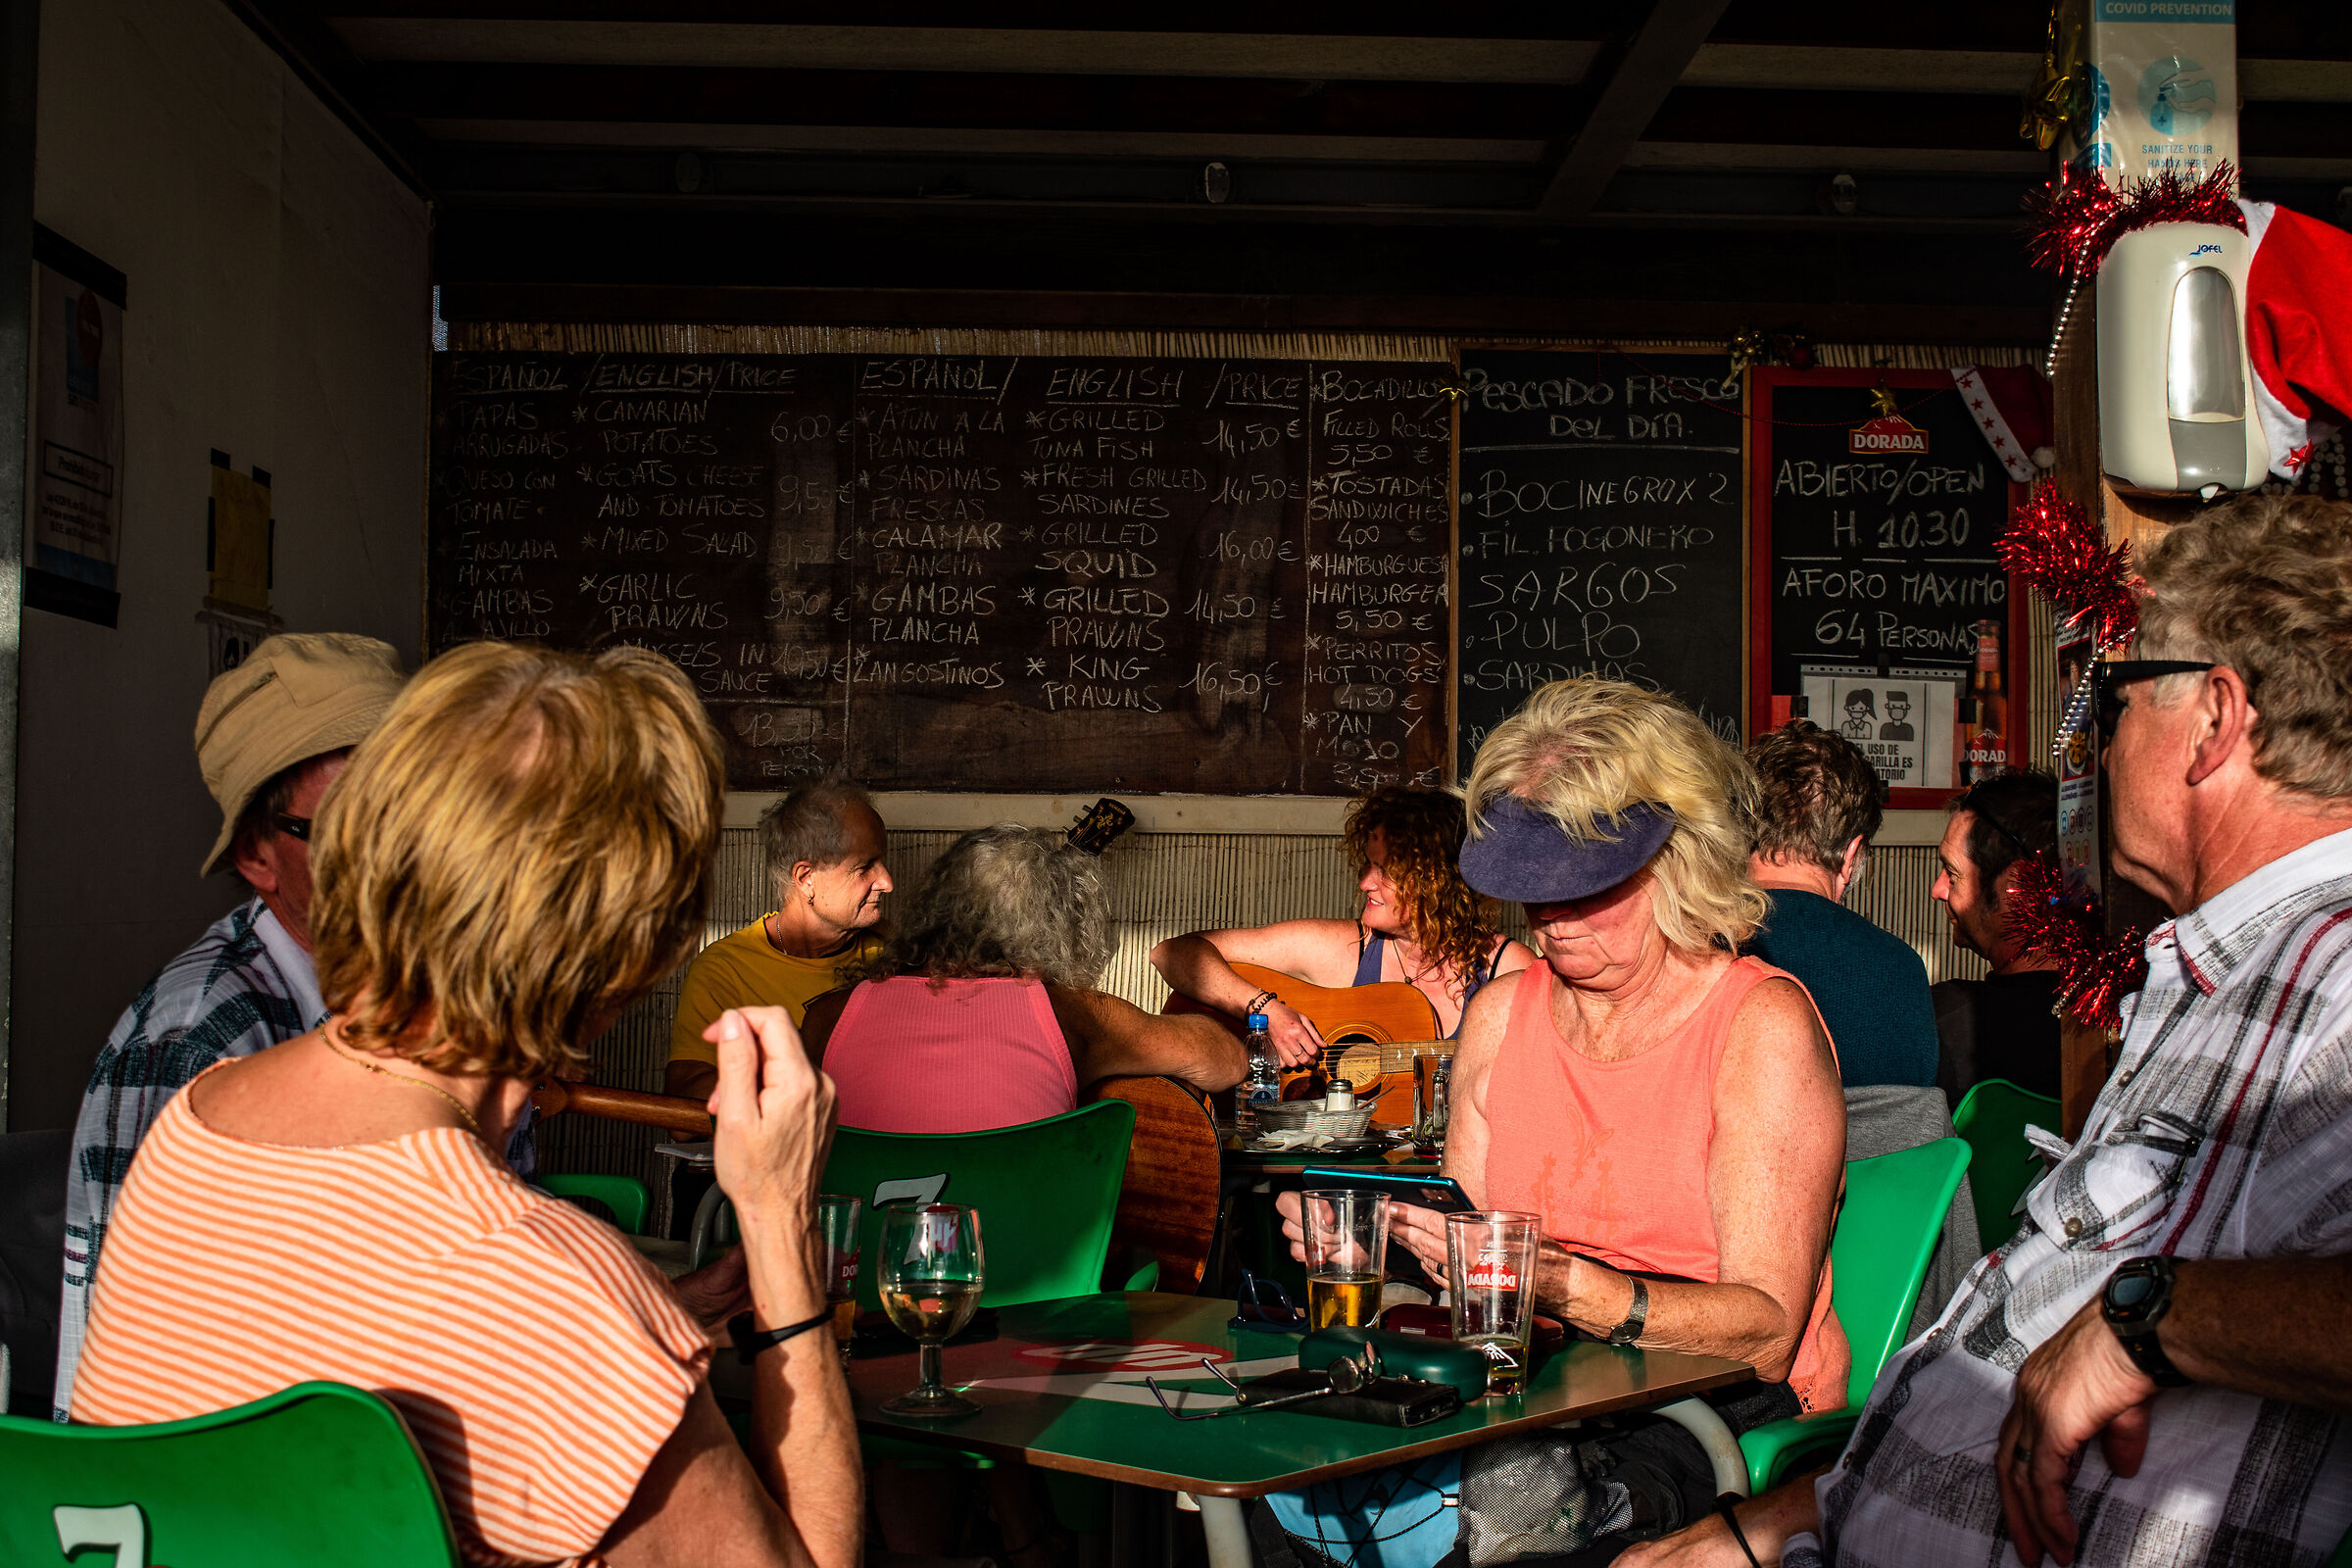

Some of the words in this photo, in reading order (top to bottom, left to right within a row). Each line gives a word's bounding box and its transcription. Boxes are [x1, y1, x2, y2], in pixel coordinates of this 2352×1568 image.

[2106, 3, 2147, 15] COVID
[2149, 3, 2232, 16] PREVENTION
[2141, 144, 2184, 154] SANITIZE
[2187, 144, 2213, 154] YOUR
[2196, 244, 2223, 254] JOFEL
[1046, 368, 1185, 398] ENGLISH
[456, 401, 539, 431] PAPAS
[594, 399, 709, 424] CANARIAN
[1049, 407, 1166, 432] GRILLED
[1323, 408, 1380, 438] FILLED
[452, 431, 570, 460] ARRUGADAS
[601, 427, 719, 457] POTATOES
[865, 432, 965, 461] PLANCHA
[1028, 436, 1084, 460] TUNA
[1097, 435, 1154, 461] FISH
[1853, 433, 1925, 450] DORADA
[524, 469, 557, 490] CON
[596, 460, 677, 488] GOATS
[878, 465, 1003, 491] SARDINAS
[1041, 466, 1114, 488] FRESH
[1128, 467, 1207, 492] GRILLED
[1327, 469, 1447, 499] TOSTADAS
[1708, 472, 1735, 505] 2
[446, 498, 533, 526] TOMATE
[598, 494, 641, 519] AND
[653, 494, 768, 519] TOMATOES
[870, 496, 987, 523] FRESCAS
[1036, 494, 1171, 519] SARDINES
[454, 531, 560, 562] ENSALADA
[602, 526, 669, 556] MIXED
[681, 522, 758, 558] SALAD
[871, 521, 1004, 552] CALAMAR
[1041, 522, 1158, 549] GRILLED
[458, 564, 525, 587] MIXTA
[1035, 548, 1157, 579] SQUID
[597, 572, 698, 605] GARLIC
[870, 583, 997, 616] GAMBAS
[1468, 562, 1687, 612] SARGOS
[1782, 566, 1886, 600] AFORO
[1900, 572, 2007, 608] MAXIMO
[450, 588, 556, 618] GAMBAS
[1043, 585, 1171, 619] GRILLED
[606, 602, 728, 633] PRAWNS
[870, 616, 980, 646] PLANCHA
[1046, 616, 1166, 653] PRAWNS
[1481, 610, 1641, 659] PULPO
[1815, 609, 1867, 649] 64
[1878, 611, 1982, 656] PERSONAS
[740, 643, 763, 666] IN
[699, 670, 772, 694] SAUCE
[1068, 656, 1151, 682] KING
[1309, 664, 1356, 684] HOT
[1365, 664, 1442, 685] DOGS
[1042, 680, 1163, 714] PRAWNS
[1320, 710, 1372, 736] PAN
[1396, 715, 1423, 738] Y
[1868, 744, 1885, 755] USO
[1887, 744, 1899, 755] DE
[1902, 757, 1913, 768] ES
